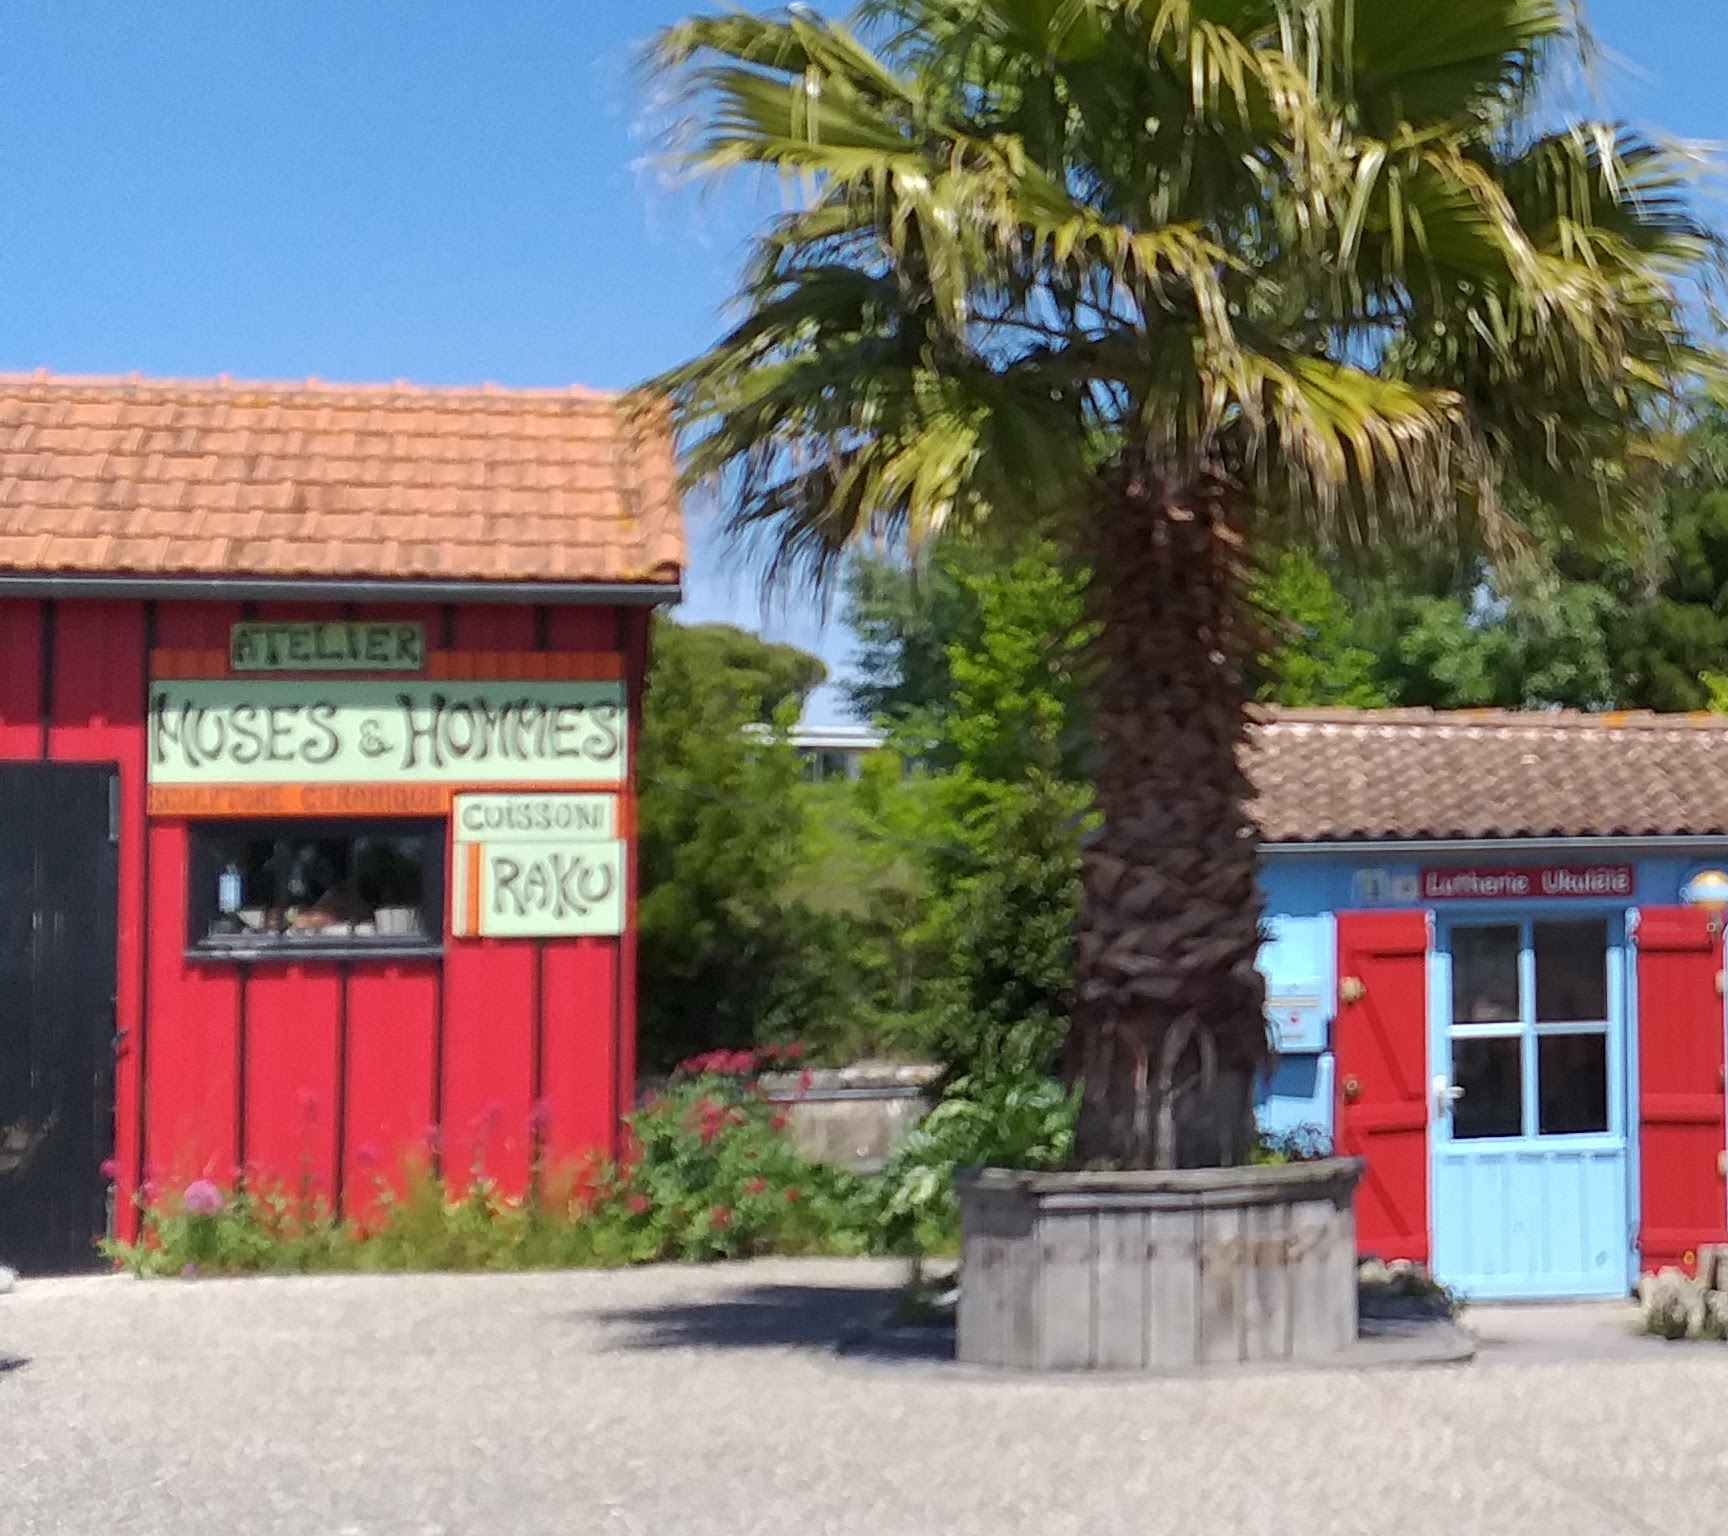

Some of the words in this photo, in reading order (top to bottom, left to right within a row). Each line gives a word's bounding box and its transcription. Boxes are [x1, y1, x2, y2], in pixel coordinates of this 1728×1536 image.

[234, 626, 421, 665] ATELIER
[153, 690, 342, 769] MUSES
[356, 717, 395, 758] &
[395, 691, 620, 770] HOMMES
[461, 798, 605, 831] CUISSON
[491, 853, 614, 920] RAKU
